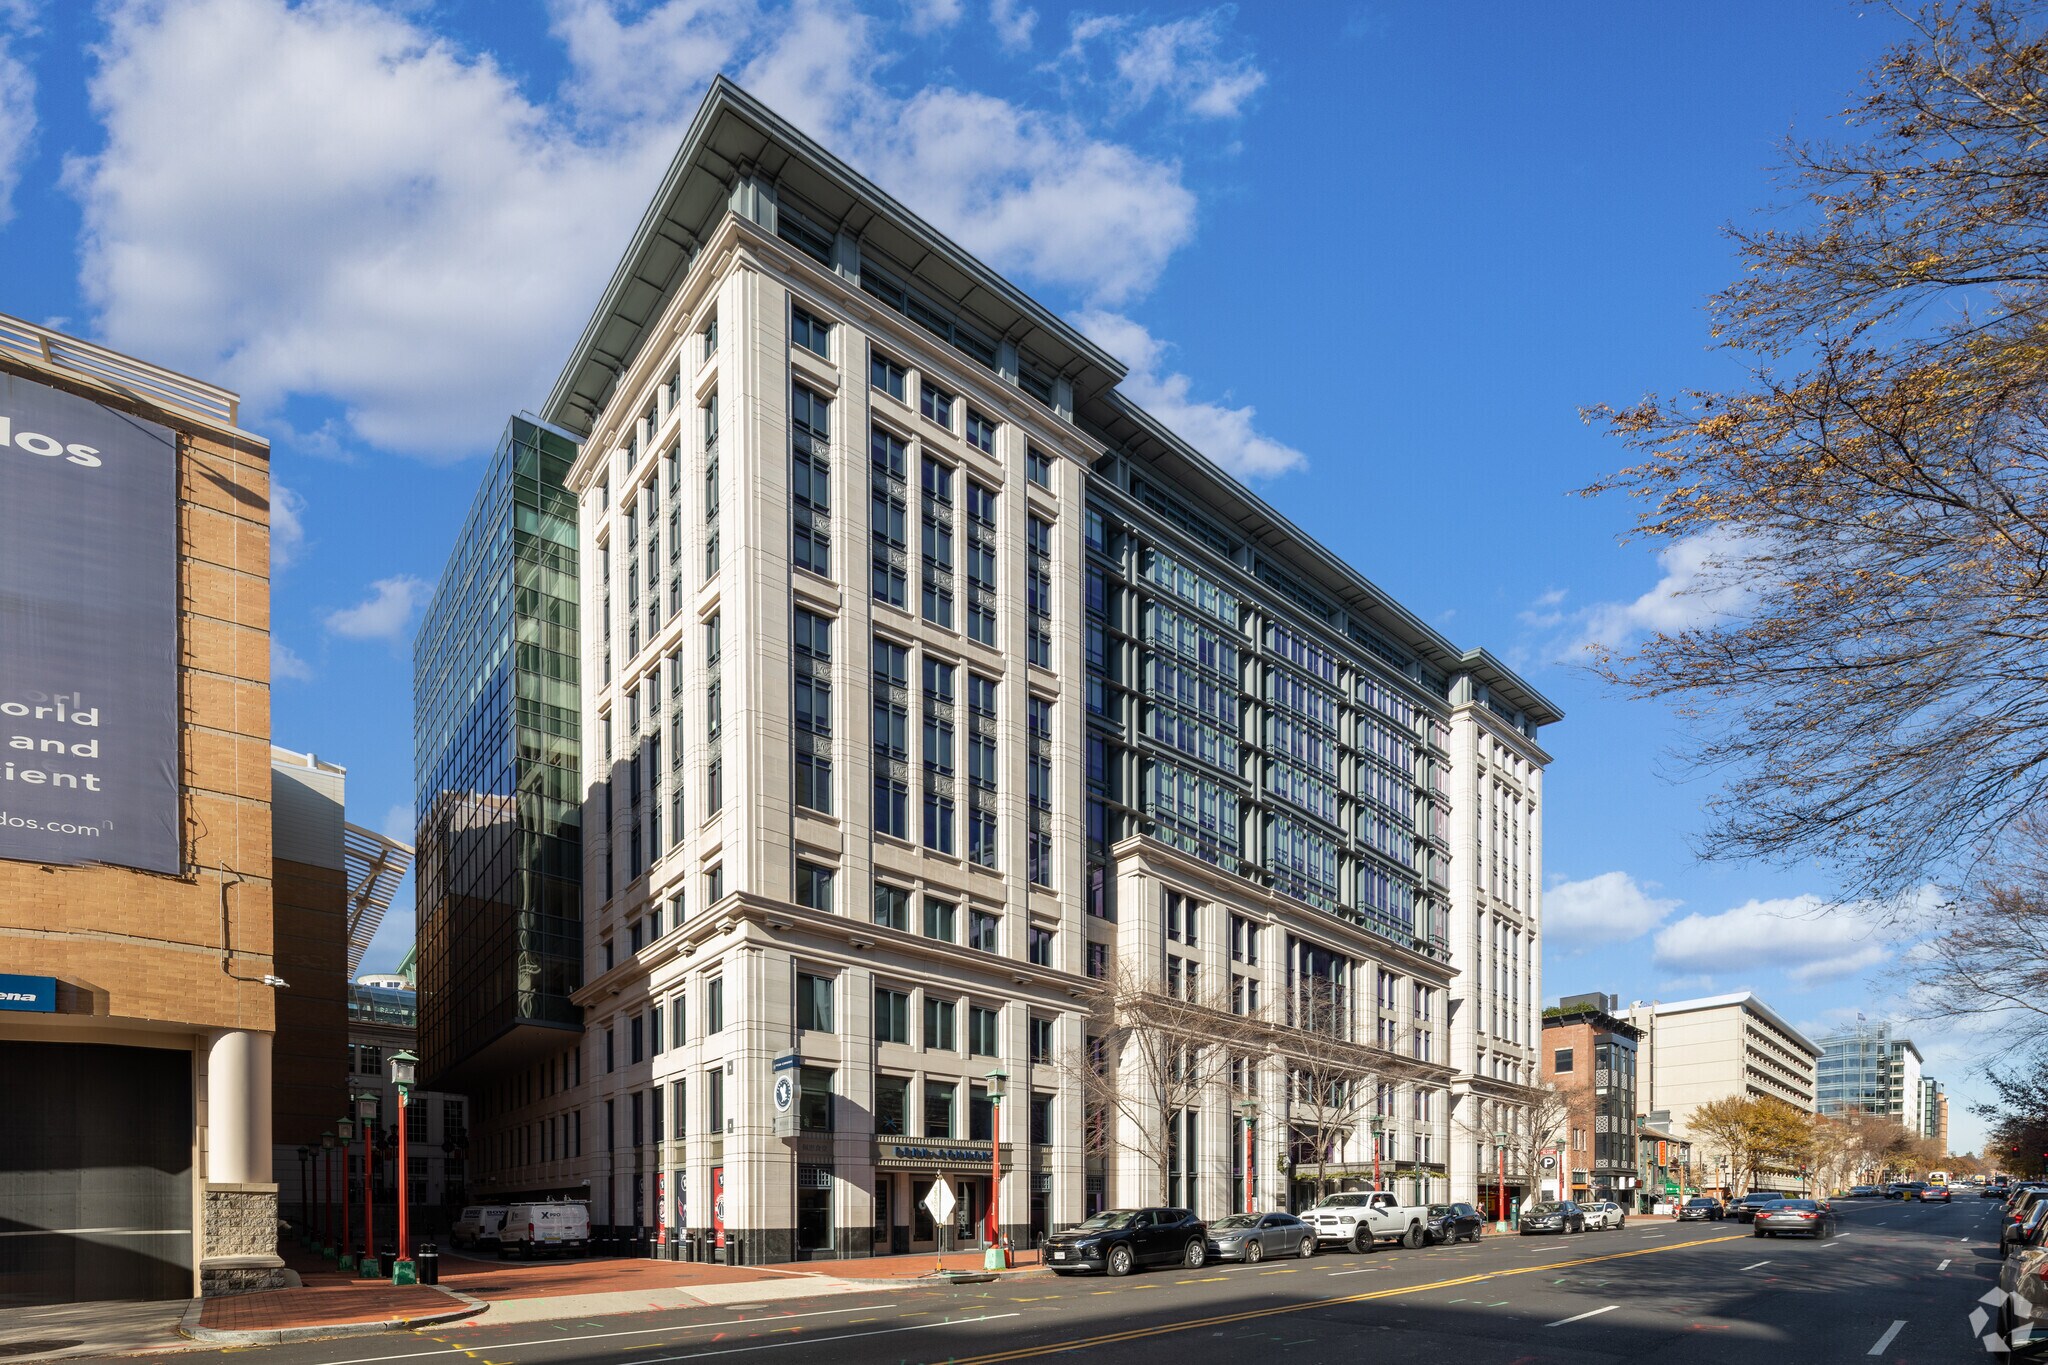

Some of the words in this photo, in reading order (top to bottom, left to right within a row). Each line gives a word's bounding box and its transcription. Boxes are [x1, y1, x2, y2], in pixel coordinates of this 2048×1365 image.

[9, 736, 99, 758] and
[0, 762, 101, 791] ient
[1544, 1158, 1554, 1168] P
